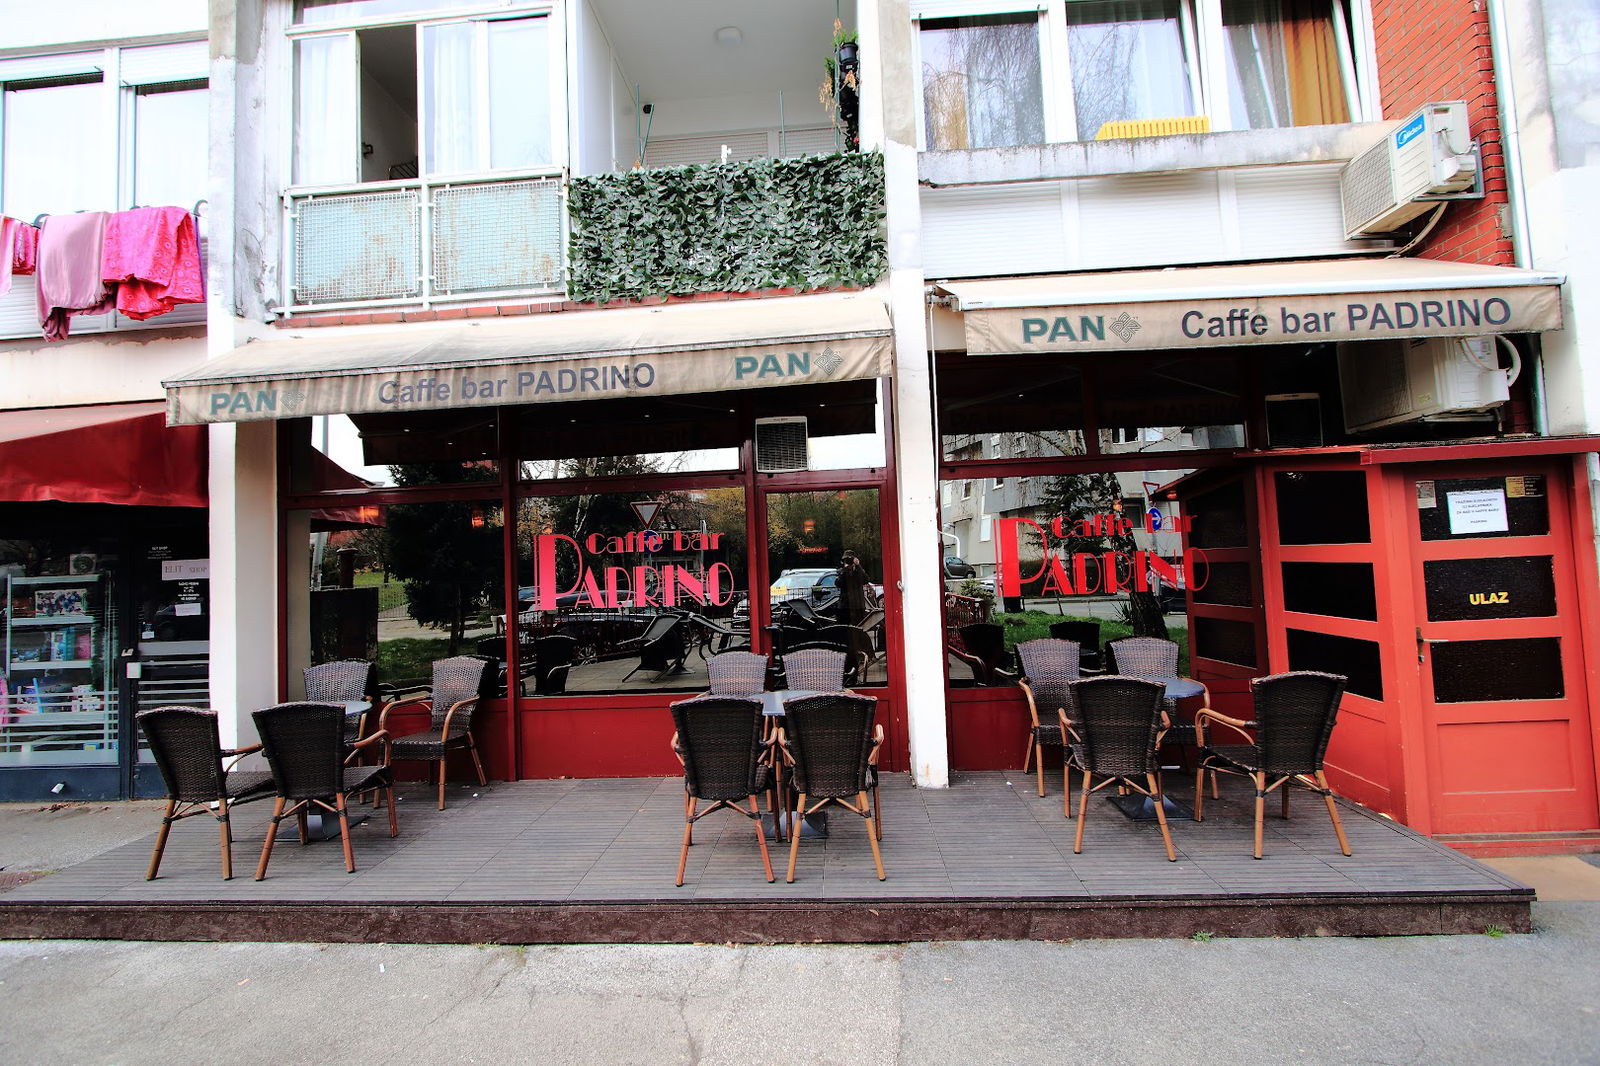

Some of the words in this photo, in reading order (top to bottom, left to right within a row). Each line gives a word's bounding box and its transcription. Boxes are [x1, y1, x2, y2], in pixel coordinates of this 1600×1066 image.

[1021, 315, 1106, 344] PAN
[1181, 308, 1269, 338] Caffe
[1281, 306, 1336, 334] bar
[1346, 297, 1511, 332] PADRINO
[210, 389, 277, 416] PAN
[378, 377, 451, 405] Caffe
[461, 375, 509, 400] bar
[517, 362, 655, 397] PADRINO
[734, 352, 811, 381] PAN
[672, 530, 725, 551] bar
[1145, 512, 1199, 533] bar
[533, 533, 735, 611] PADRINO
[993, 516, 1210, 598] PADRINO
[1469, 591, 1510, 605] ULAZ
